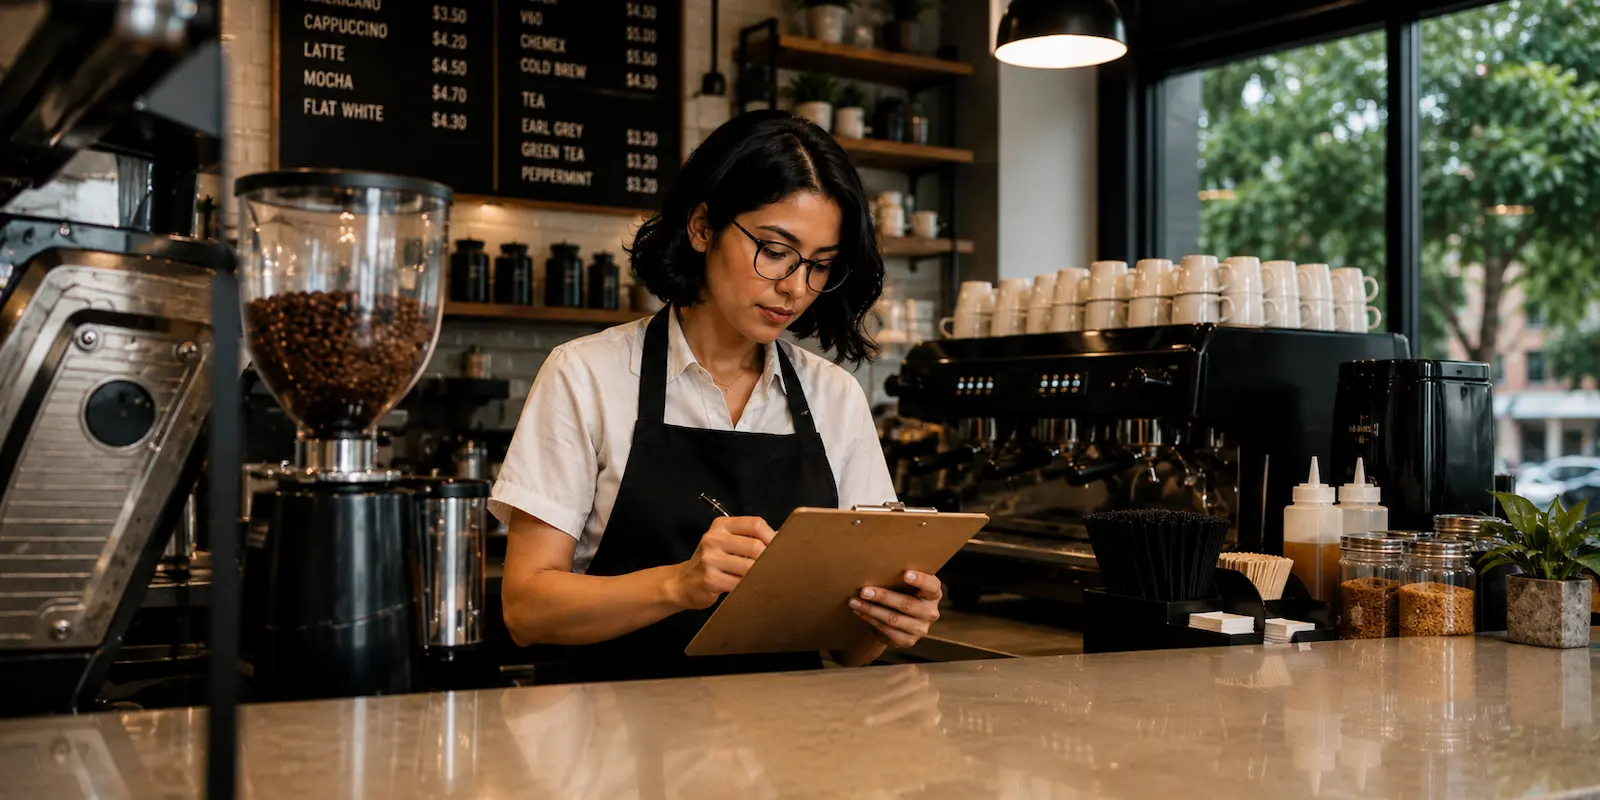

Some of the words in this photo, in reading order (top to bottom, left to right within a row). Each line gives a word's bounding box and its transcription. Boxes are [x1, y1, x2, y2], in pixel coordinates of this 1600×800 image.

[433, 4, 468, 24] $3.50
[303, 13, 389, 39] CAPPUCCINO
[432, 30, 468, 50] $4.20
[520, 33, 567, 53] CHEMEX
[303, 41, 346, 62] LATTE
[432, 56, 468, 76] $4.50
[520, 57, 551, 75] COLD
[554, 61, 588, 80] BREW
[303, 69, 354, 90] MOCHA
[431, 83, 468, 104] $4.70
[522, 90, 546, 109] TEA
[303, 97, 338, 117] FLAT
[341, 101, 384, 122] WHITE
[431, 111, 468, 131] $4.30
[521, 117, 551, 136] EARL
[553, 120, 584, 139] GREY
[521, 141, 560, 159] GREEN
[563, 145, 585, 162] TEA
[521, 165, 594, 187] PEPPERMINT
